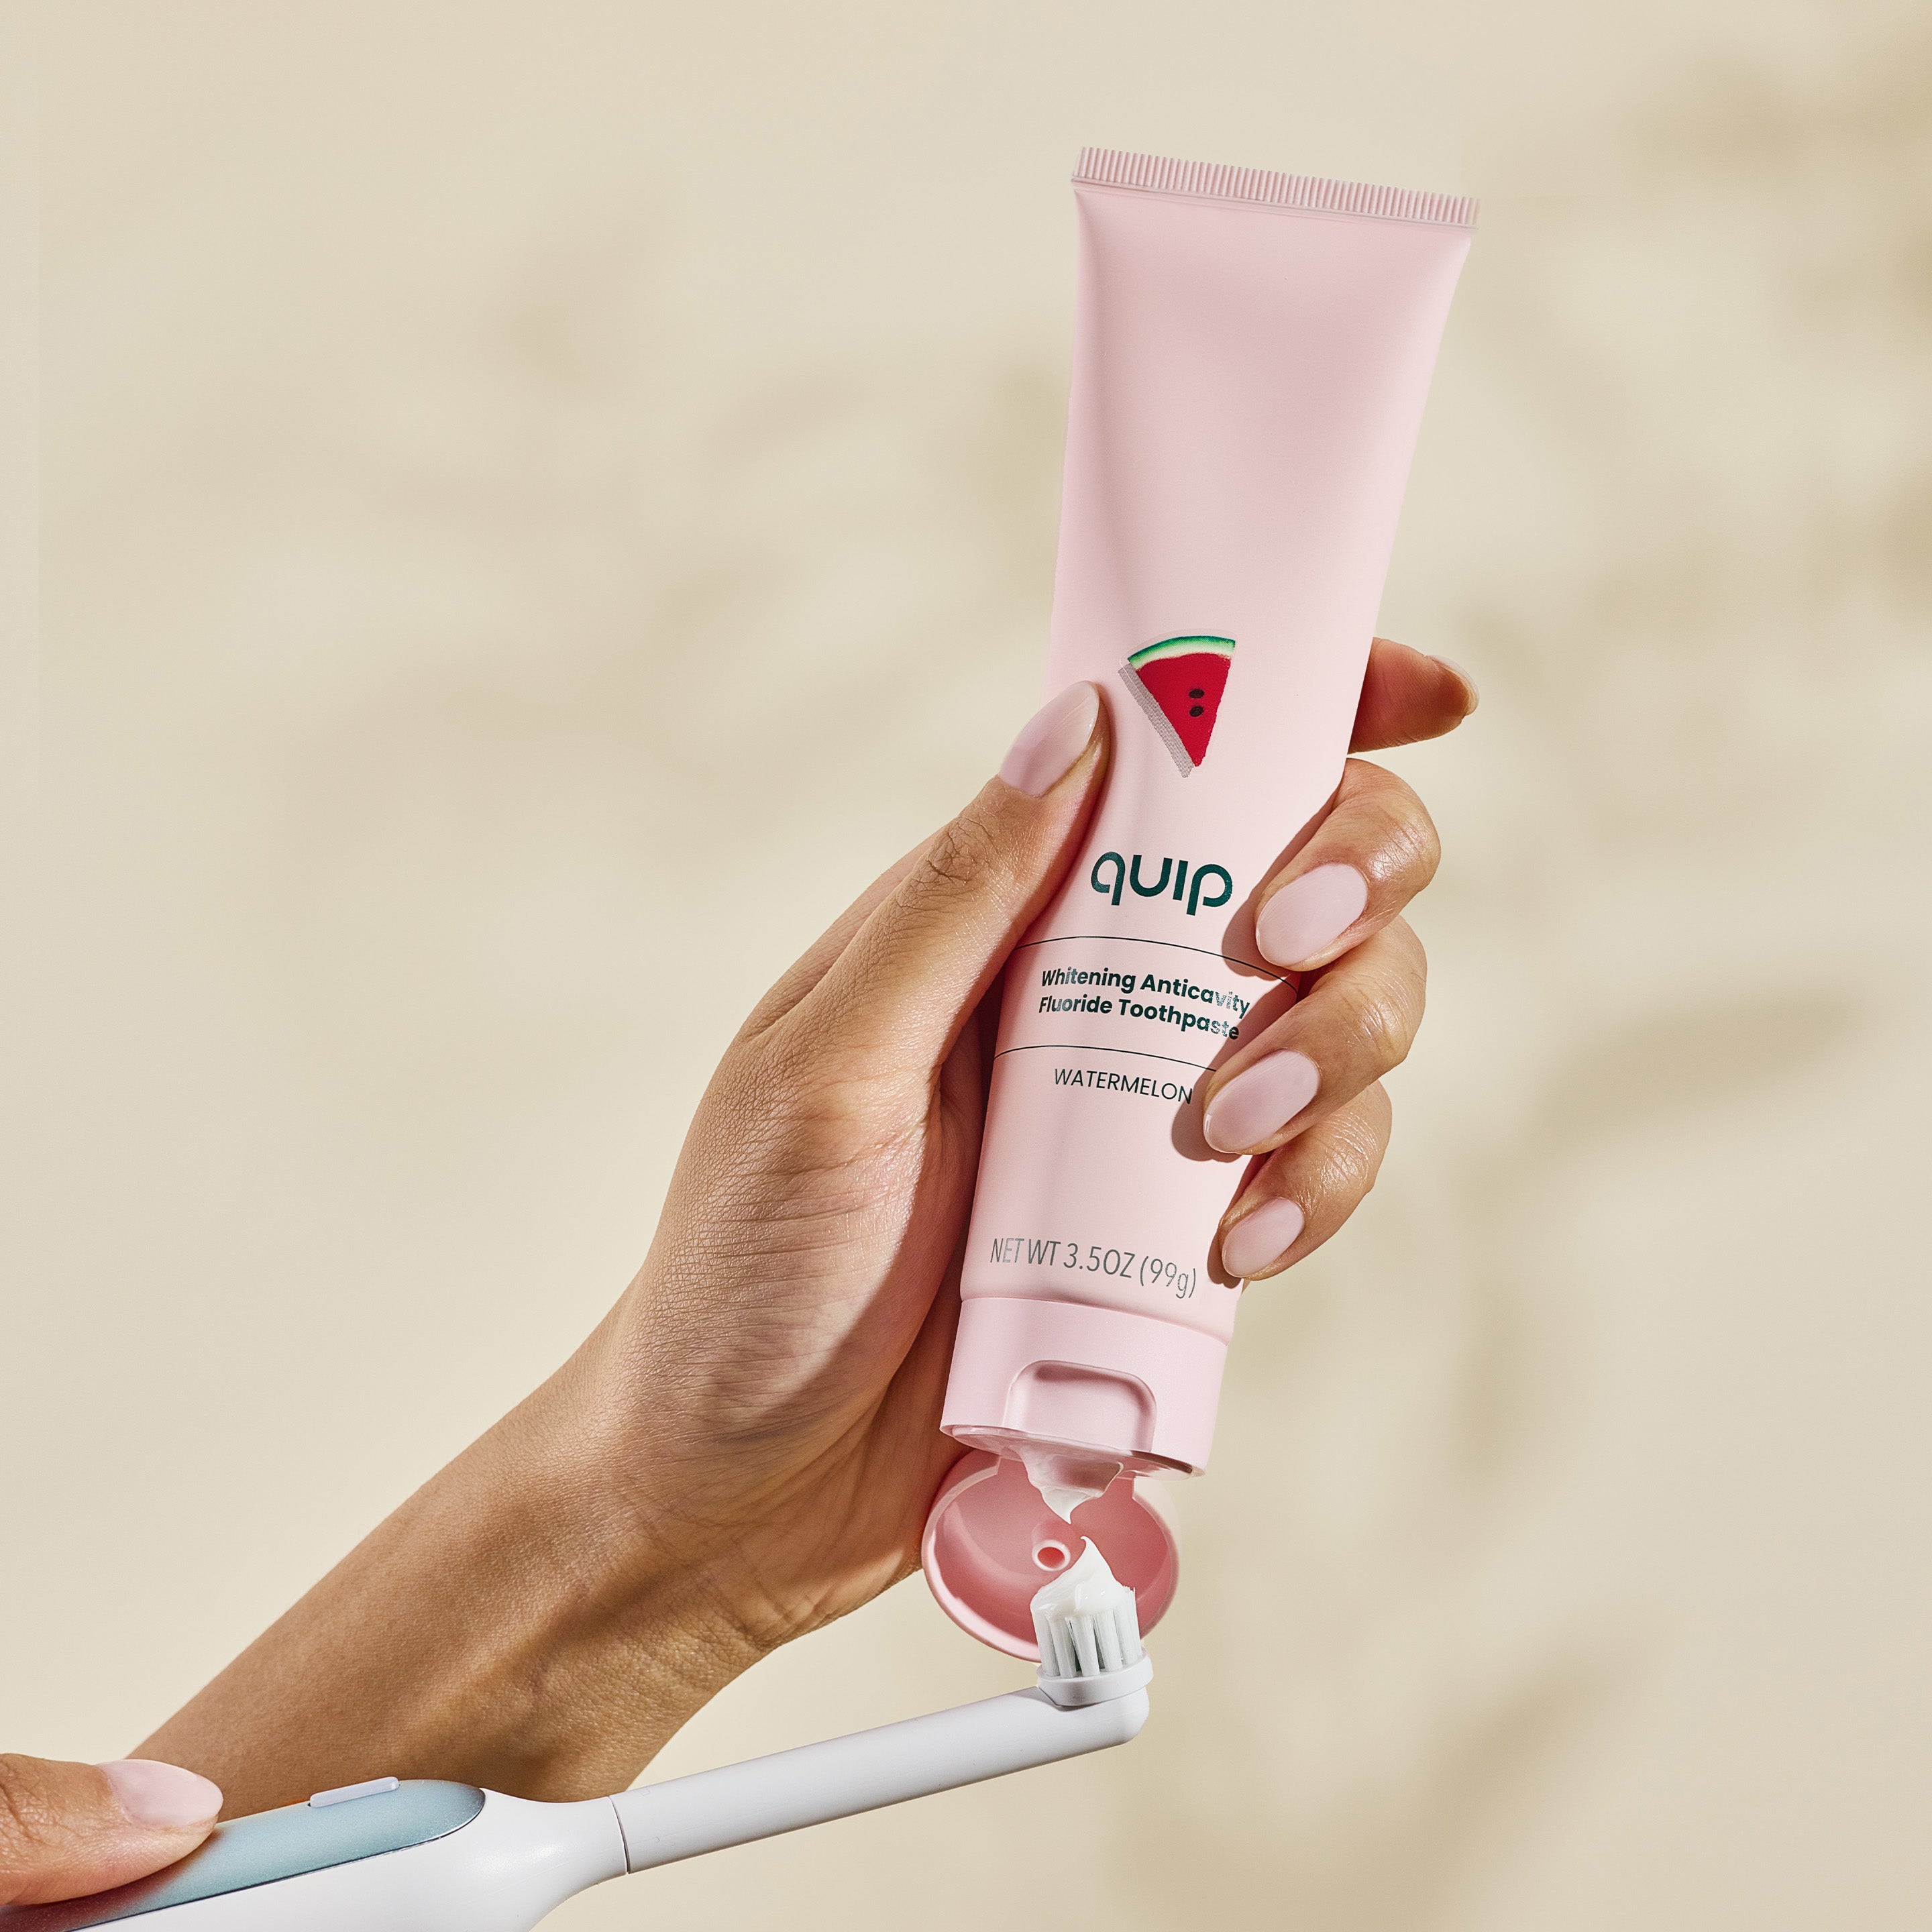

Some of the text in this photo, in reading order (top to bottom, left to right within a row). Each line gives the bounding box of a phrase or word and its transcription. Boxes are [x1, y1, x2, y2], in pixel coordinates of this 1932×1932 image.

[1091, 851, 1233, 916] quip
[1038, 995, 1240, 1040] Fluoride Toothpaste
[1042, 966, 1250, 1019] Whitening Anticavity
[1054, 1068, 1193, 1105] WATERMELON
[990, 1237, 1025, 1263] NET
[1028, 1239, 1061, 1267] WT
[1140, 1255, 1196, 1299] (99g)
